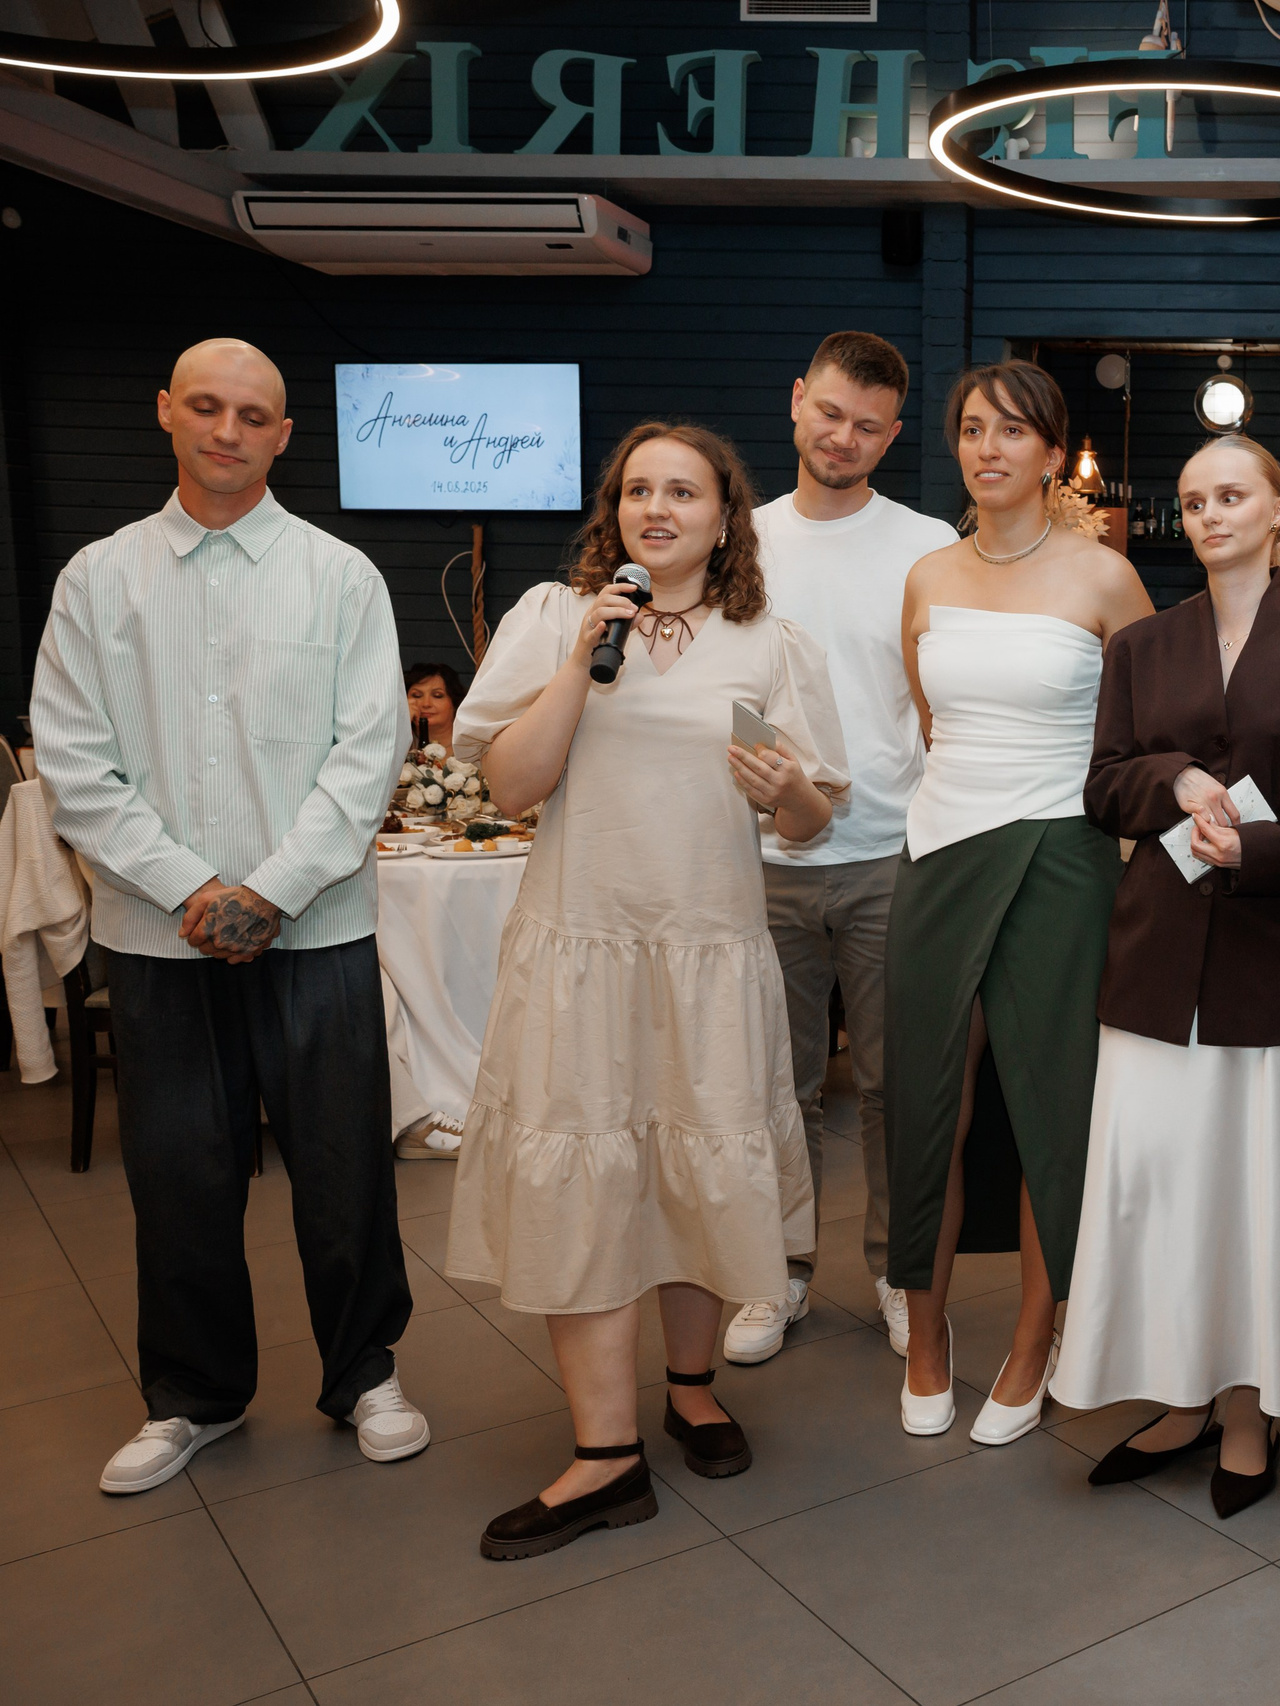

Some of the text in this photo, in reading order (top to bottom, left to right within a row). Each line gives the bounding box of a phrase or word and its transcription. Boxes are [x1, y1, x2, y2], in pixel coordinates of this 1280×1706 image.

[356, 391, 470, 448] Ангелина
[443, 413, 545, 470] и Андрей
[432, 481, 489, 494] 14.08.2025
